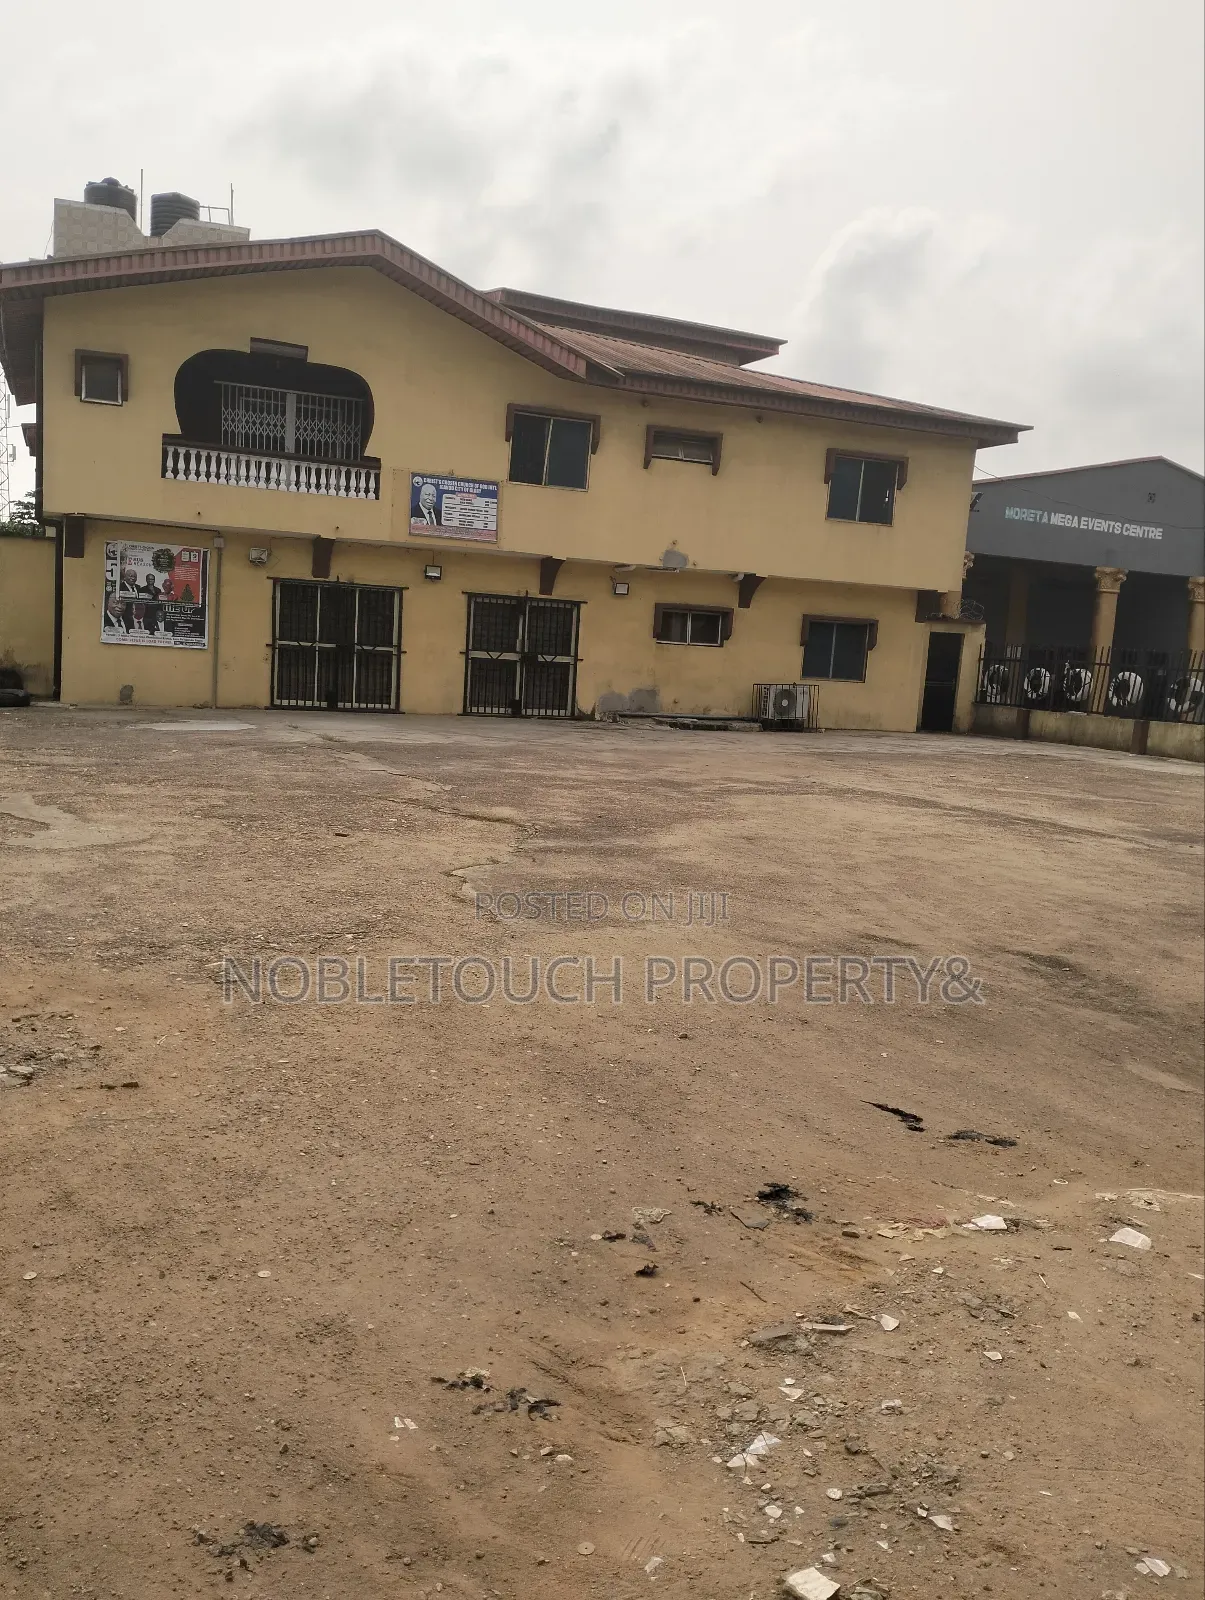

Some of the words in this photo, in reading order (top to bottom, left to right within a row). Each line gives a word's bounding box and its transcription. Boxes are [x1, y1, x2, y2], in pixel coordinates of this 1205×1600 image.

[1050, 512, 1079, 528] MEGA
[1080, 517, 1122, 534] EVENTS
[1122, 524, 1164, 540] CENTRE
